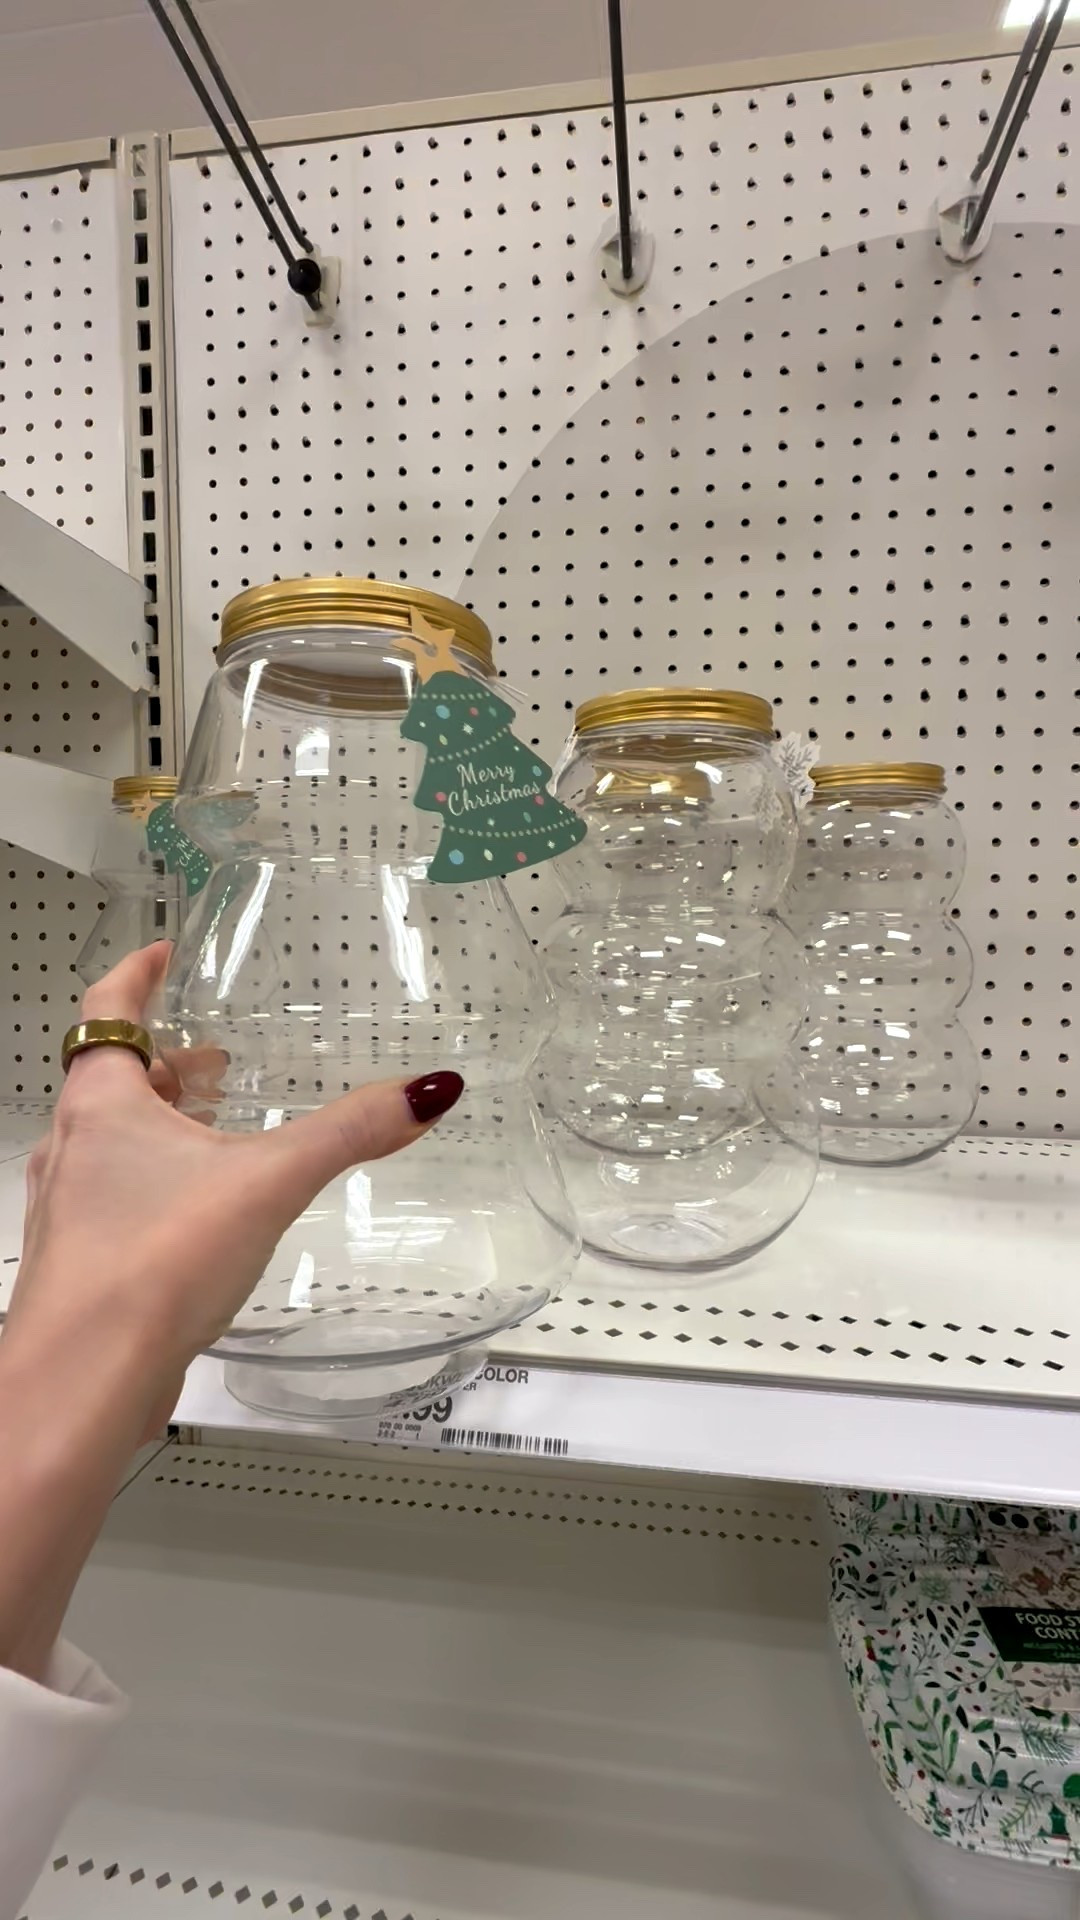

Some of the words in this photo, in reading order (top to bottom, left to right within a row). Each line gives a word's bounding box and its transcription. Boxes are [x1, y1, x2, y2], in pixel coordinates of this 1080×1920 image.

[456, 762, 515, 788] Merry
[448, 781, 541, 816] Christmas
[1015, 1612, 1063, 1626] FOOD
[1034, 1626, 1080, 1640] CONT
